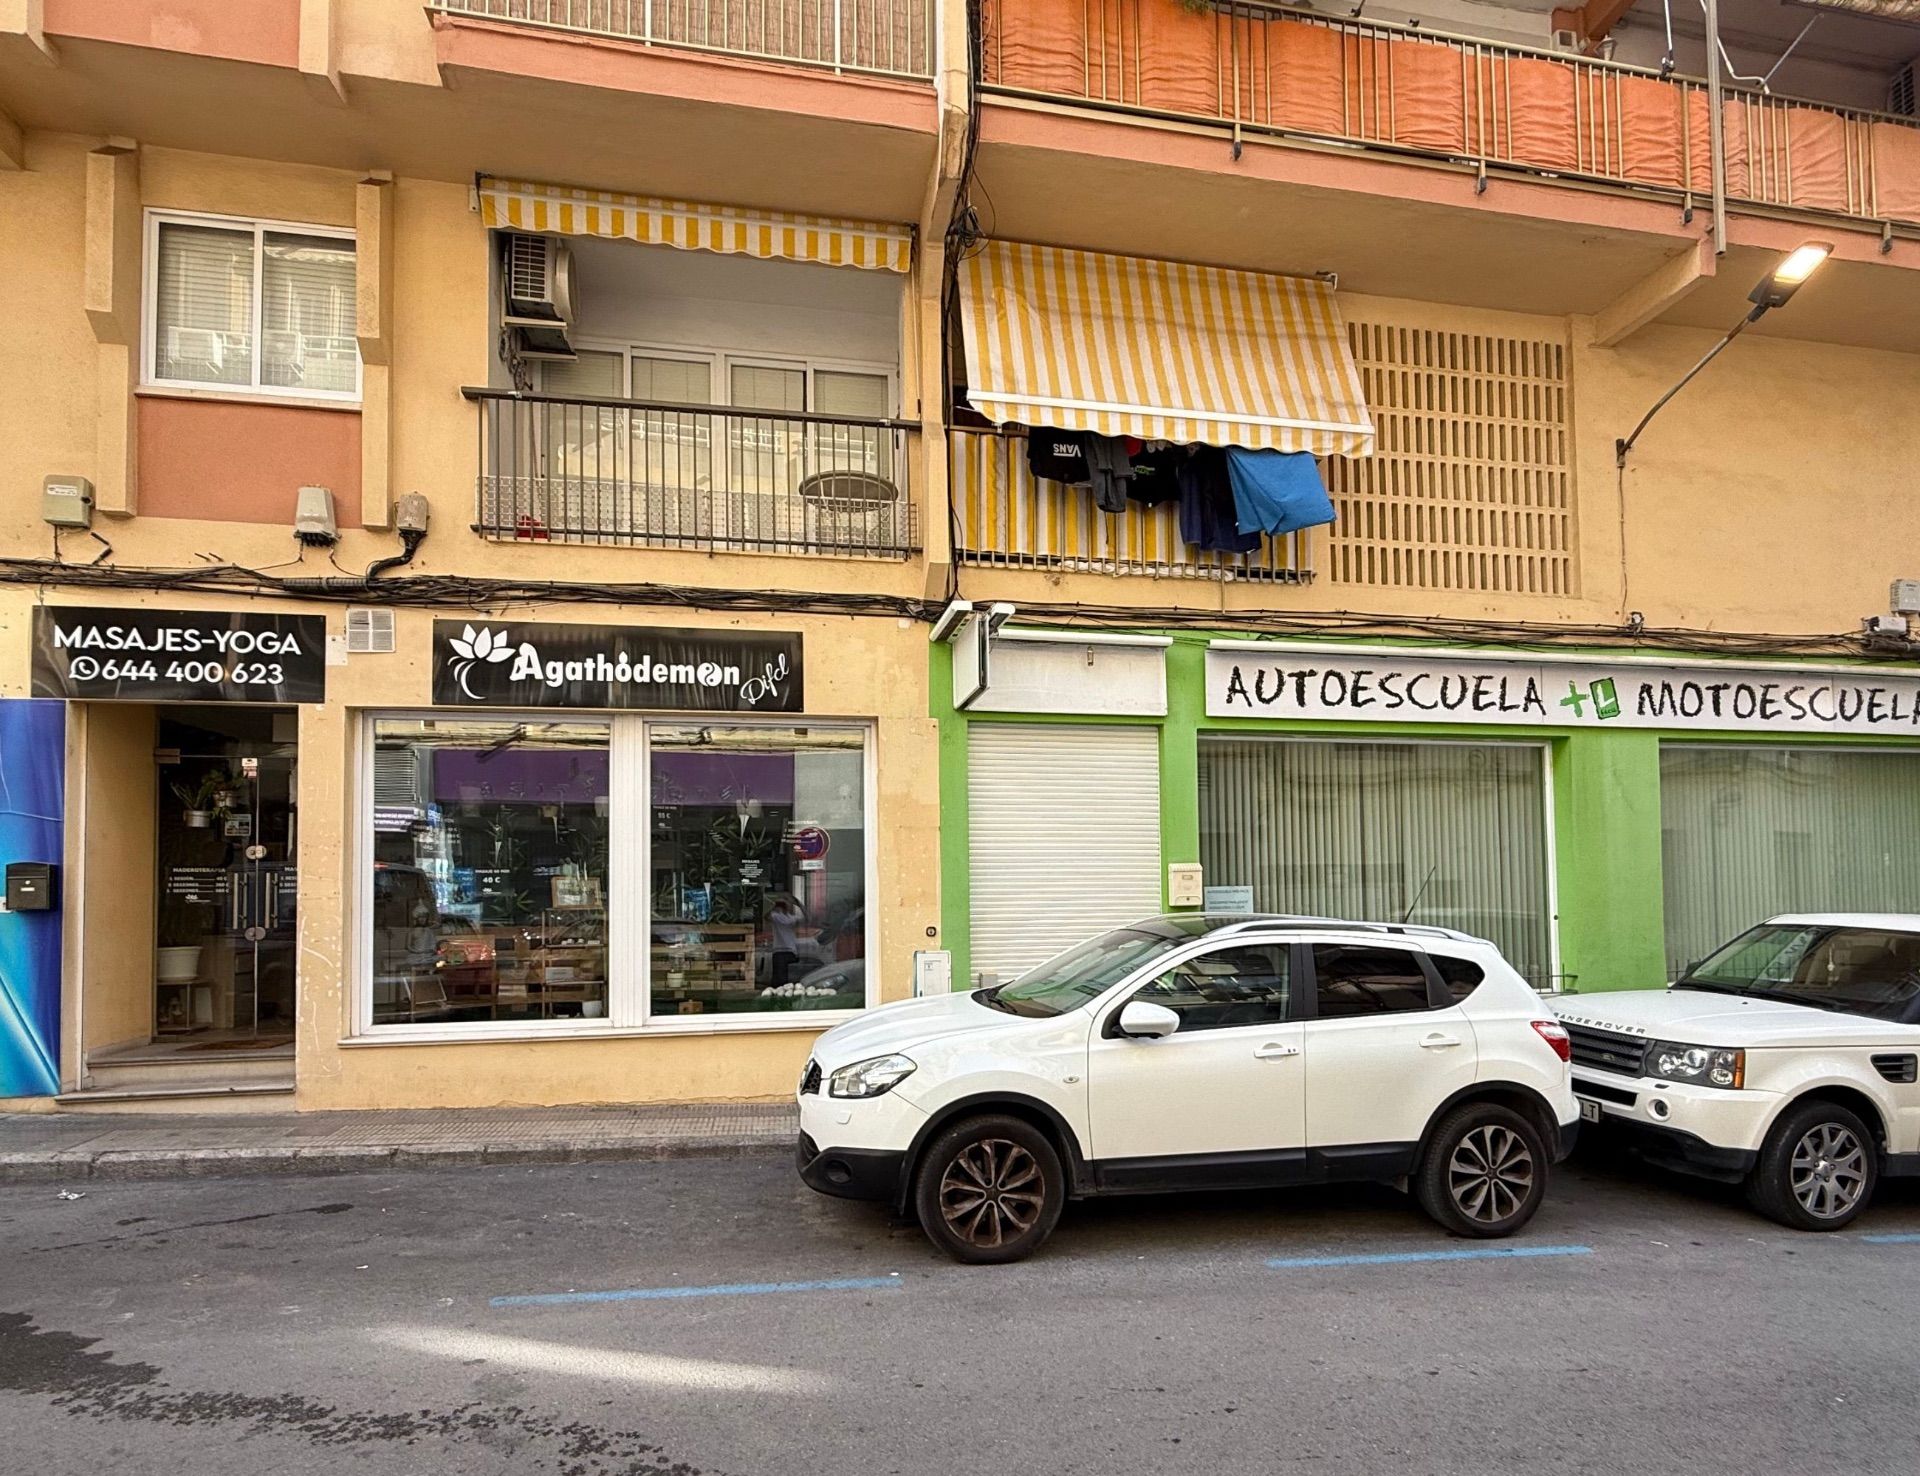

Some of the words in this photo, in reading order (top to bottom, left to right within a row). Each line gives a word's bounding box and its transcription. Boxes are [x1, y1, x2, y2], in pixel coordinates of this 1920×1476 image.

[1053, 443, 1082, 458] VANS
[54, 624, 302, 655] MASAJES-YOGA
[101, 659, 158, 681] 644
[165, 661, 224, 683] 400
[230, 662, 285, 685] 623
[509, 642, 740, 688] Agathodemon
[1226, 665, 1548, 716] AUTOESCUELA
[1553, 1012, 1591, 1024] RANGE
[1594, 1020, 1646, 1034] ROVER
